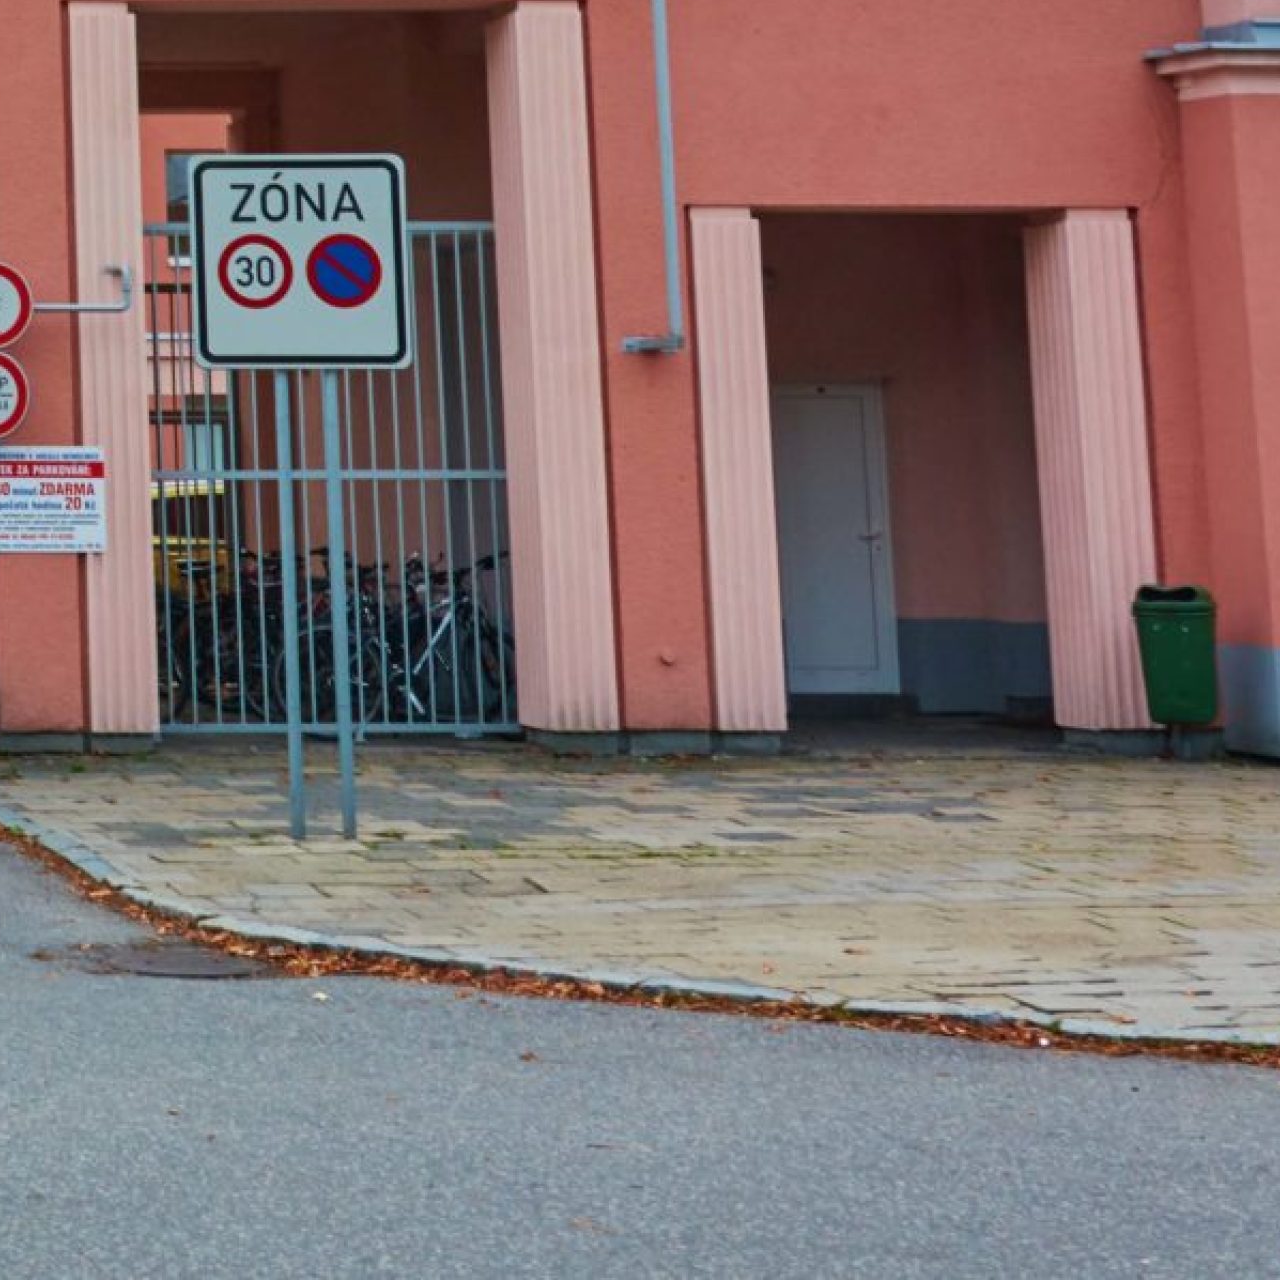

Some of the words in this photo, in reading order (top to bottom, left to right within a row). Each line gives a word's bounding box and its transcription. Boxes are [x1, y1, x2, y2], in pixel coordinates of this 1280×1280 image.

[230, 172, 365, 223] ZÓNA
[234, 255, 275, 288] 30
[40, 481, 95, 496] ZDARMA
[65, 496, 81, 511] 20
